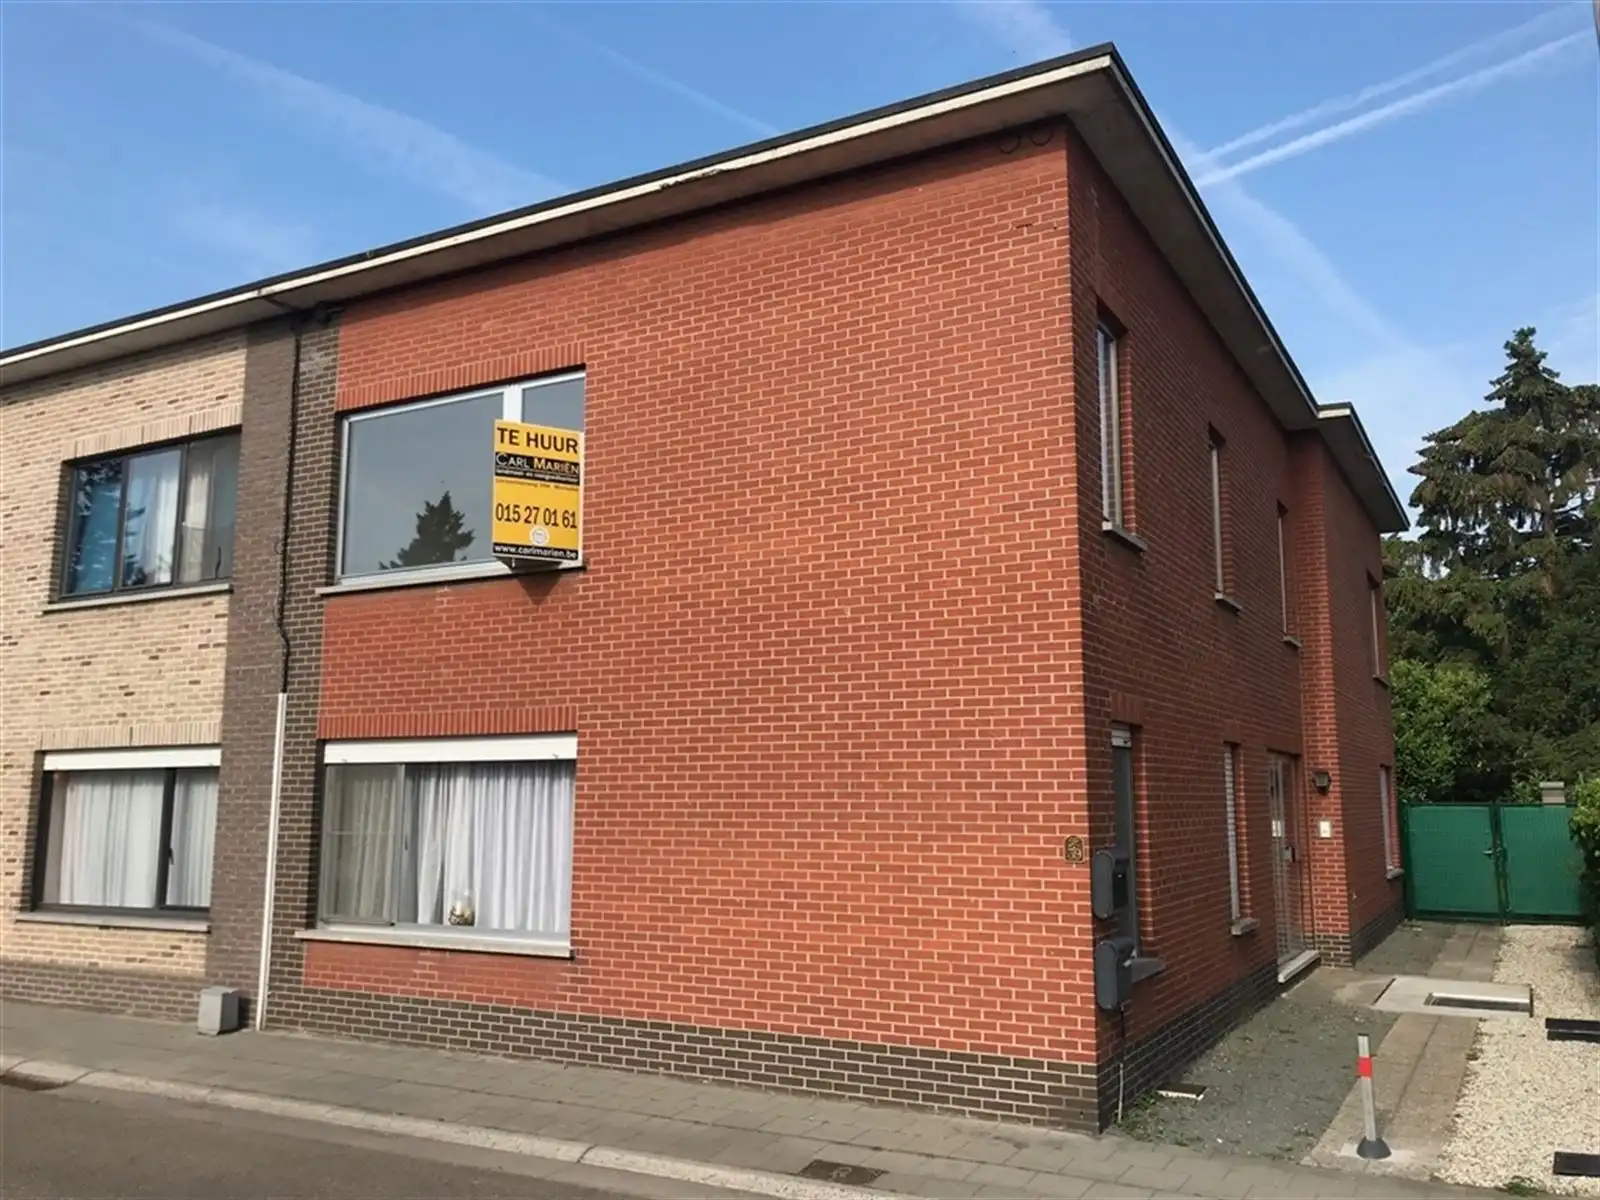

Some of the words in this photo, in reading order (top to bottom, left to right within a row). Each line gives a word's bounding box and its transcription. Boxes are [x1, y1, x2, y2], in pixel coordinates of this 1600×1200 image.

[496, 427, 520, 446] TE
[526, 431, 578, 454] HUUR
[495, 503, 521, 523] 015
[524, 505, 540, 525] 27
[543, 508, 559, 527] 01
[561, 510, 578, 529] 61
